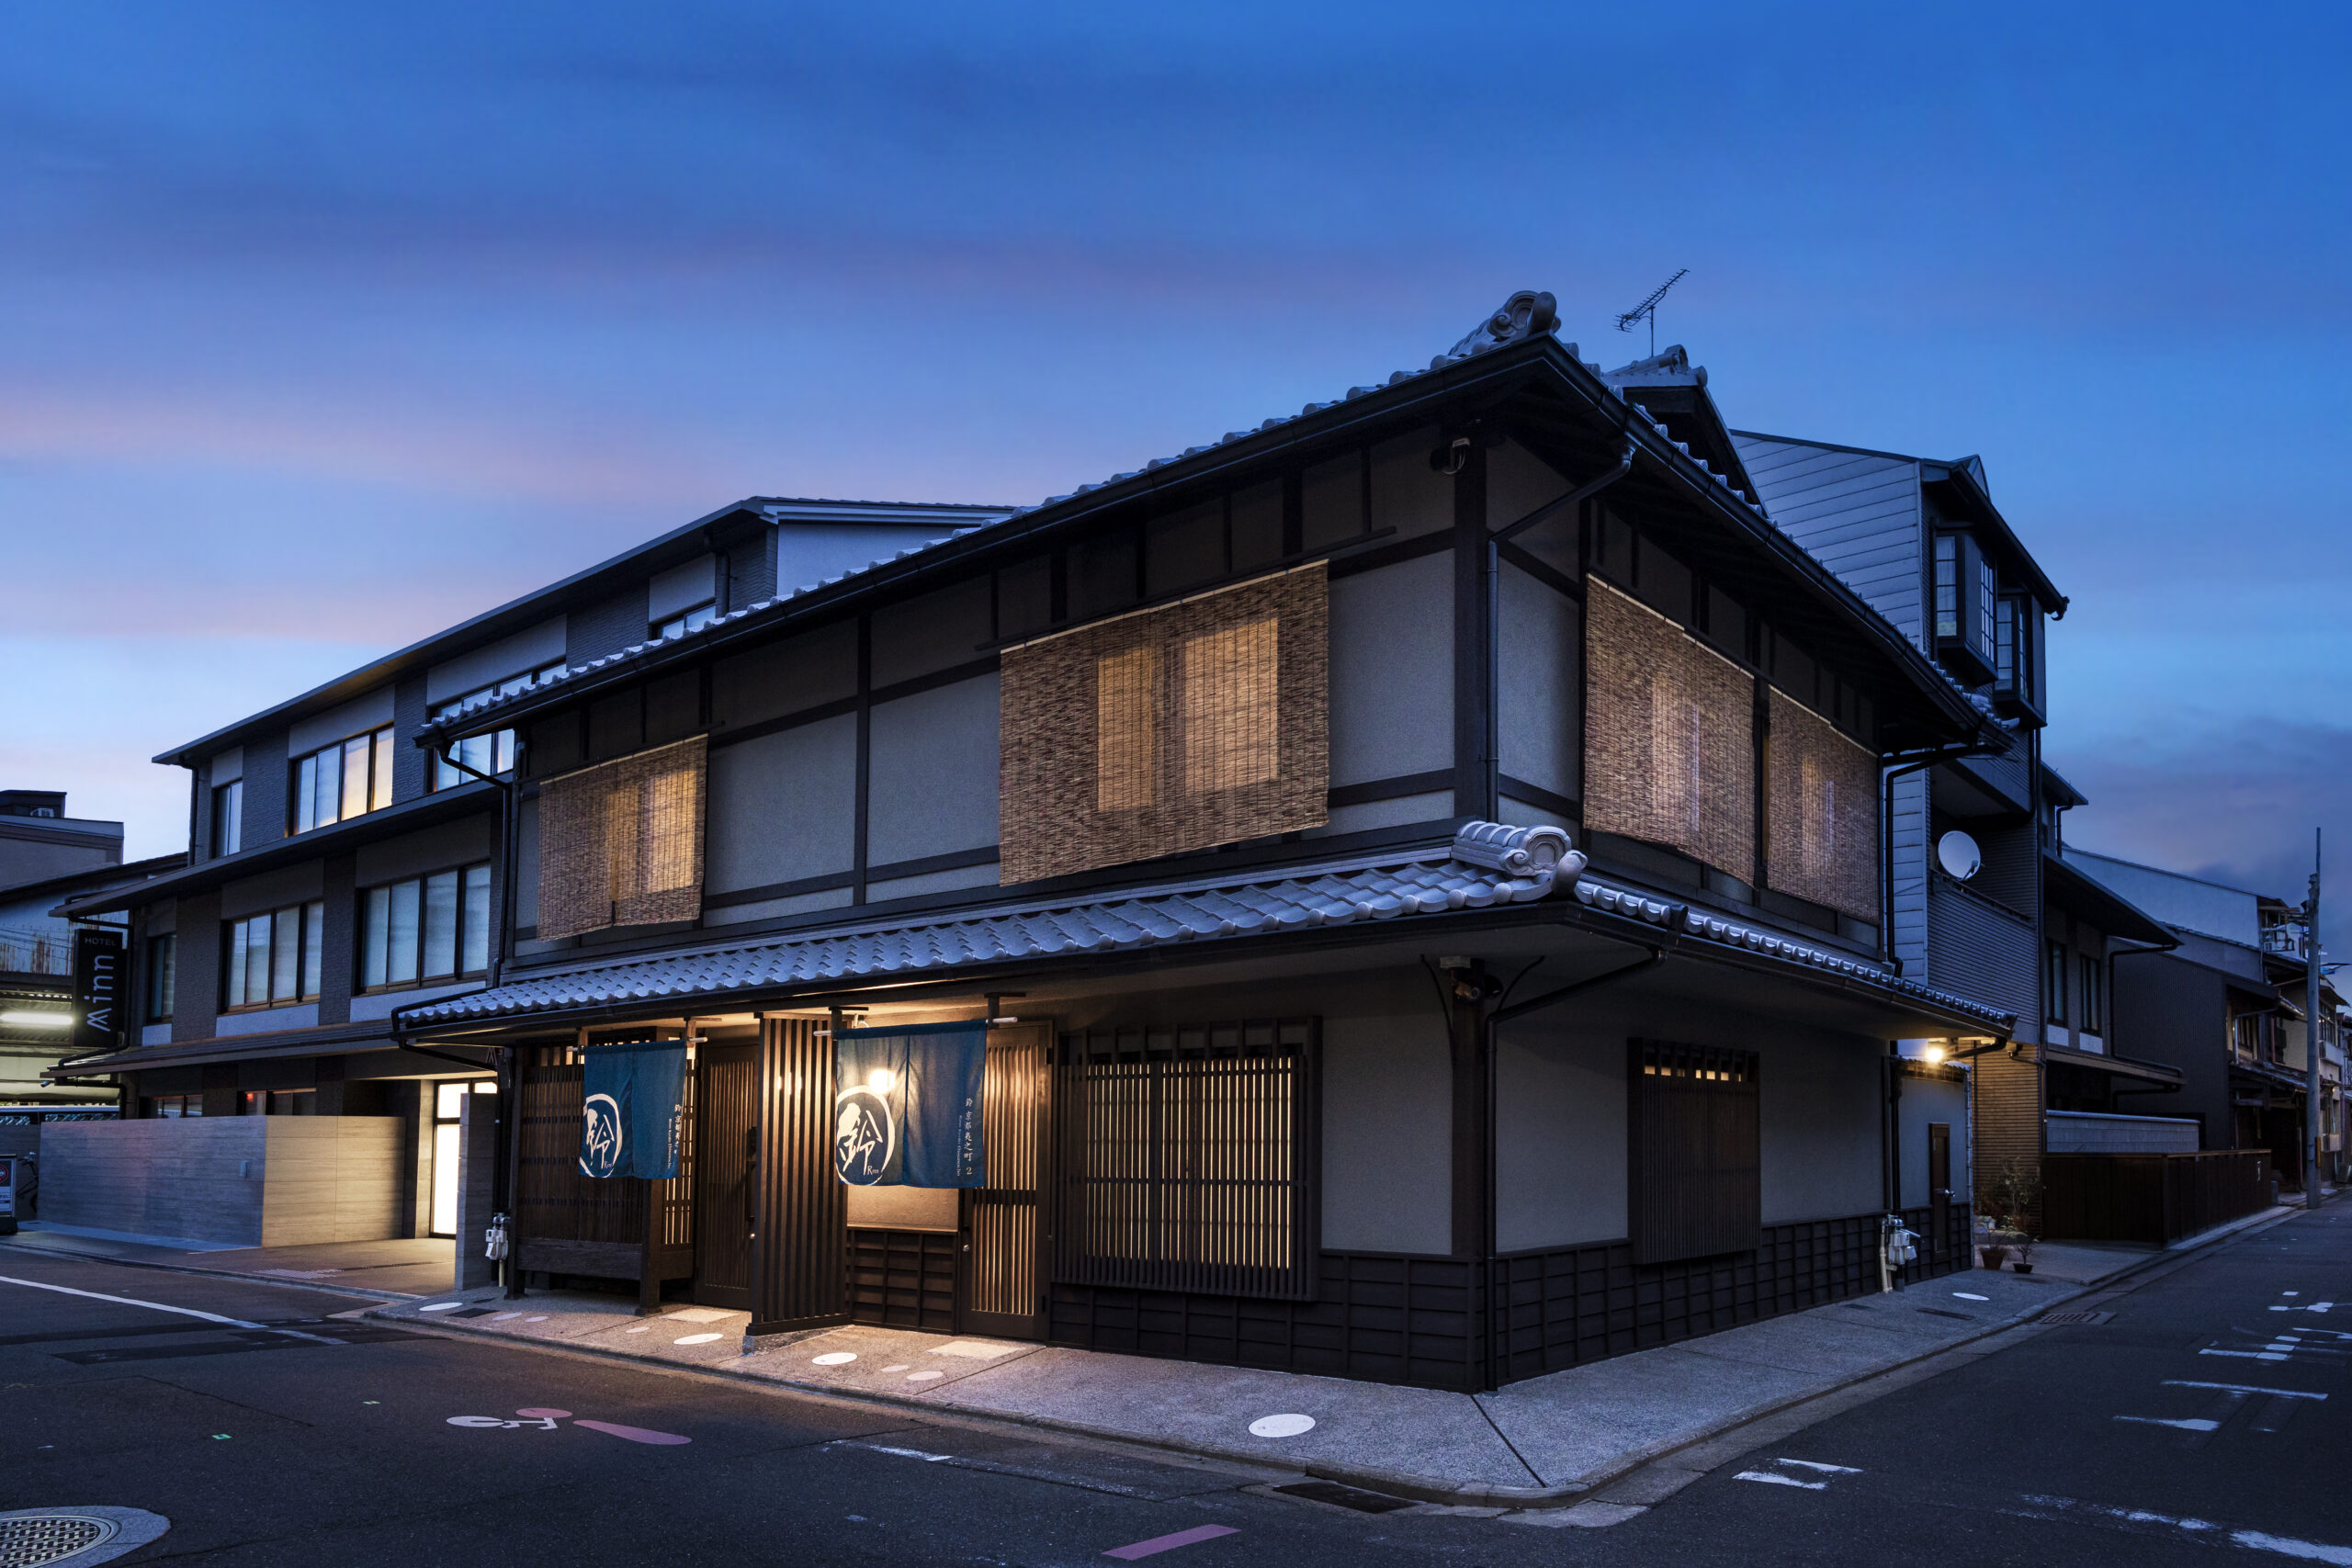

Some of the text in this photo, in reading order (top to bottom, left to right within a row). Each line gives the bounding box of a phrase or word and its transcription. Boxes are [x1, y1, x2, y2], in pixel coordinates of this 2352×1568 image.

[85, 937, 117, 946] HOTEL
[84, 954, 115, 1032] Minn
[966, 1167, 973, 1175] 2
